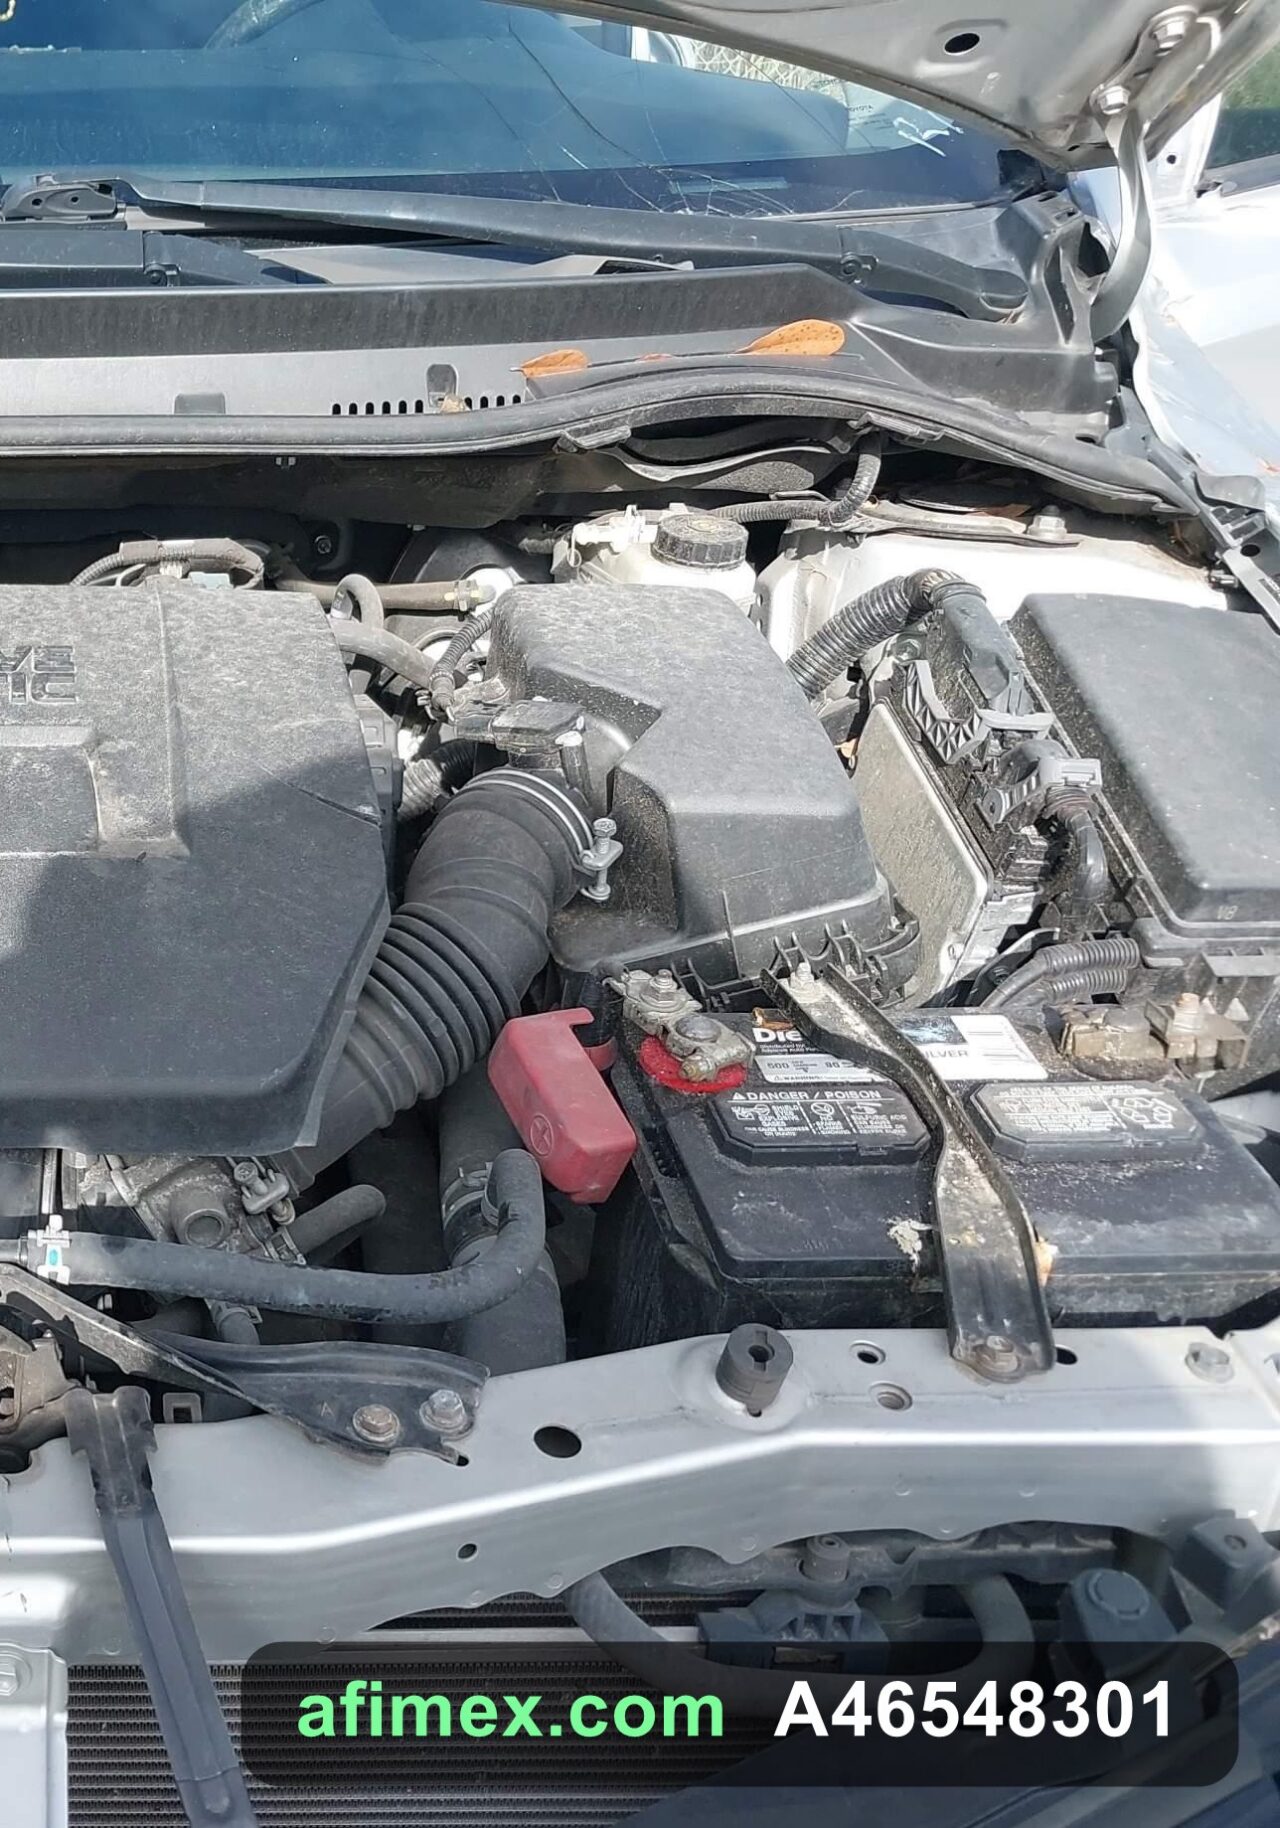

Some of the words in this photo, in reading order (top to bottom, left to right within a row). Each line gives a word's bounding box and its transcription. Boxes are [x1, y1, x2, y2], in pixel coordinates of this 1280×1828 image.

[924, 1049, 969, 1058] ILVER
[745, 1091, 810, 1100] DANGER
[825, 1090, 882, 1099] POISON
